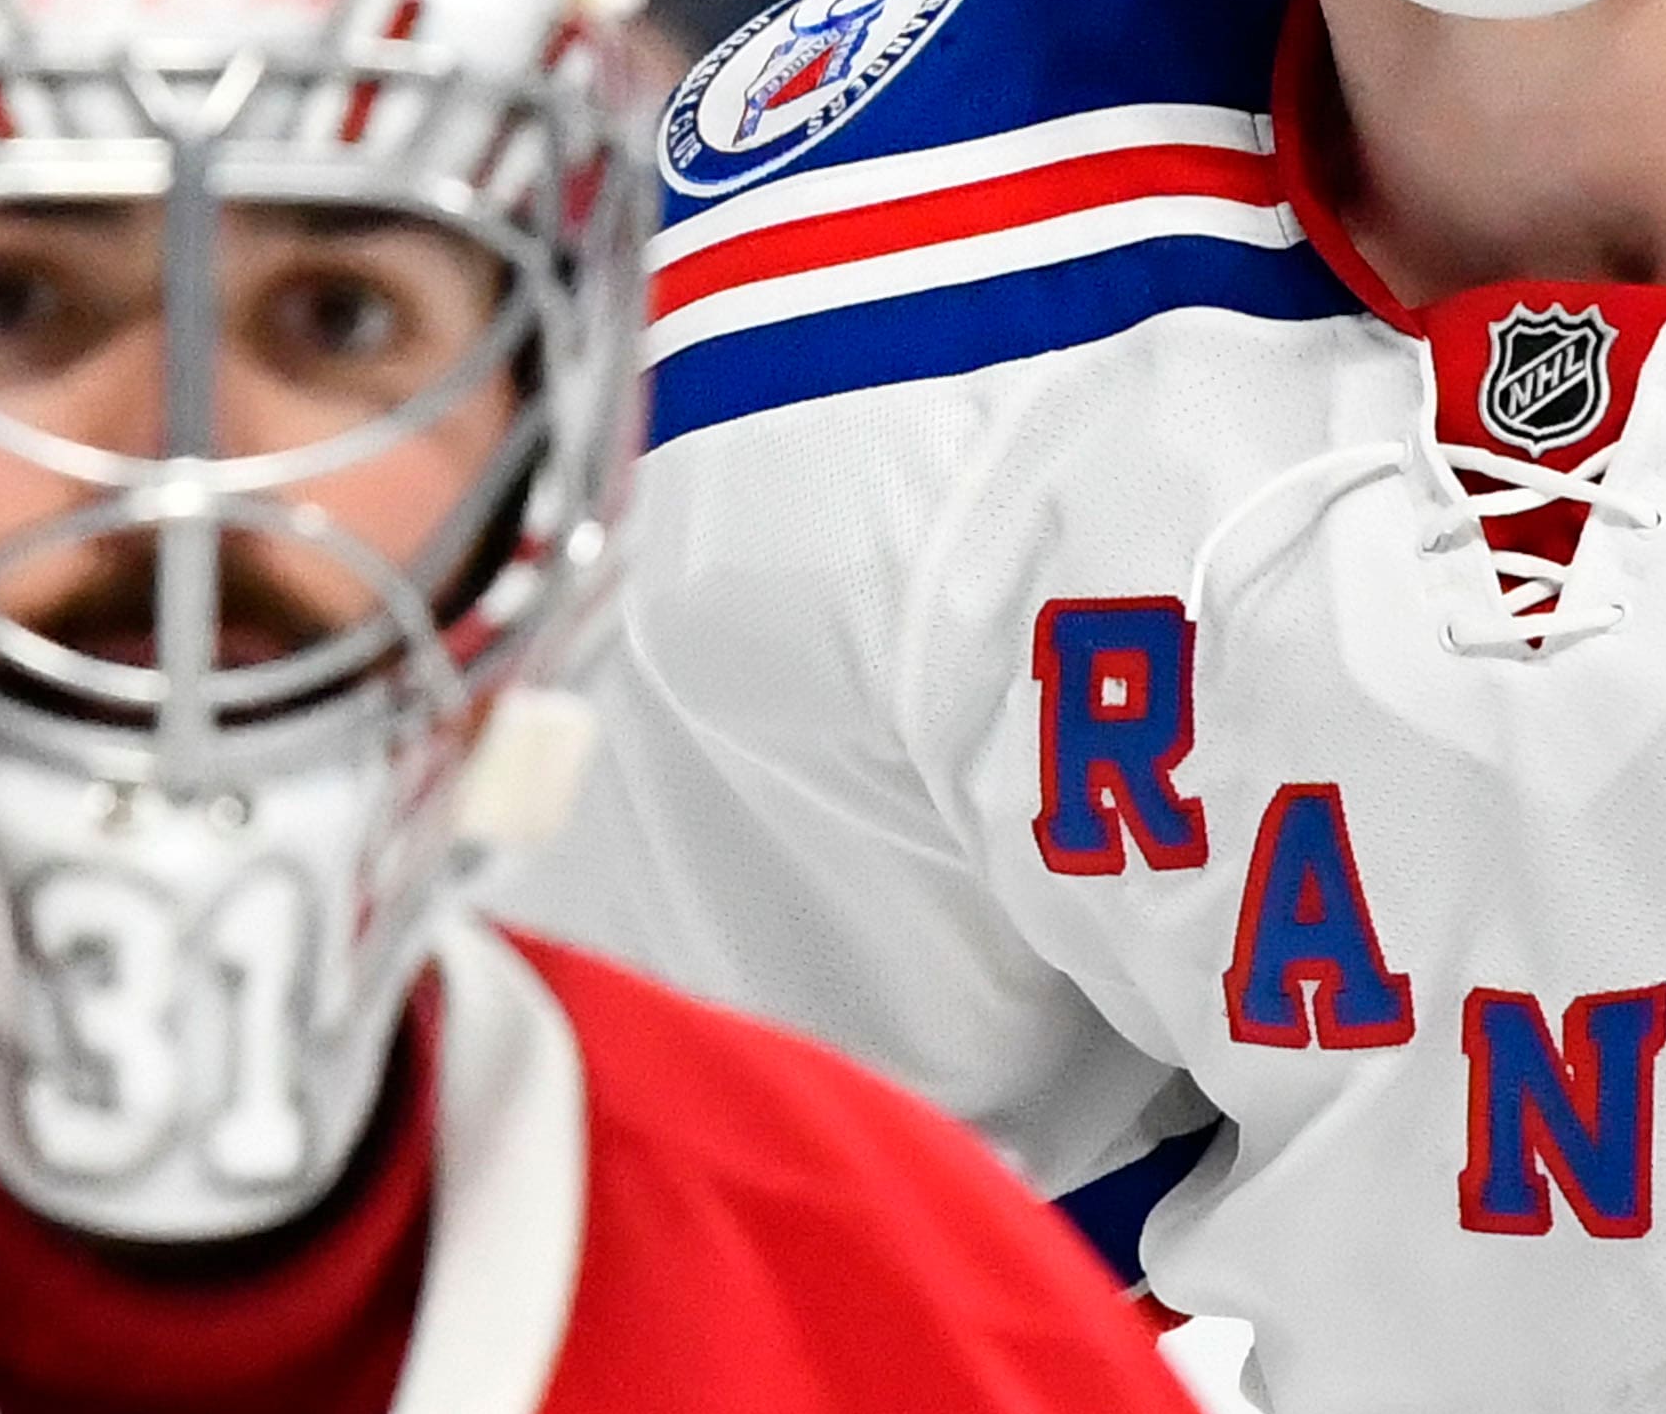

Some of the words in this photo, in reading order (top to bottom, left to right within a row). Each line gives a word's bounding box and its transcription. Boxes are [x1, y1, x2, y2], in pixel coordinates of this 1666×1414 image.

[669, 110, 703, 170] CLUB
[1507, 344, 1585, 418] NHL
[25, 867, 305, 1180] 31
